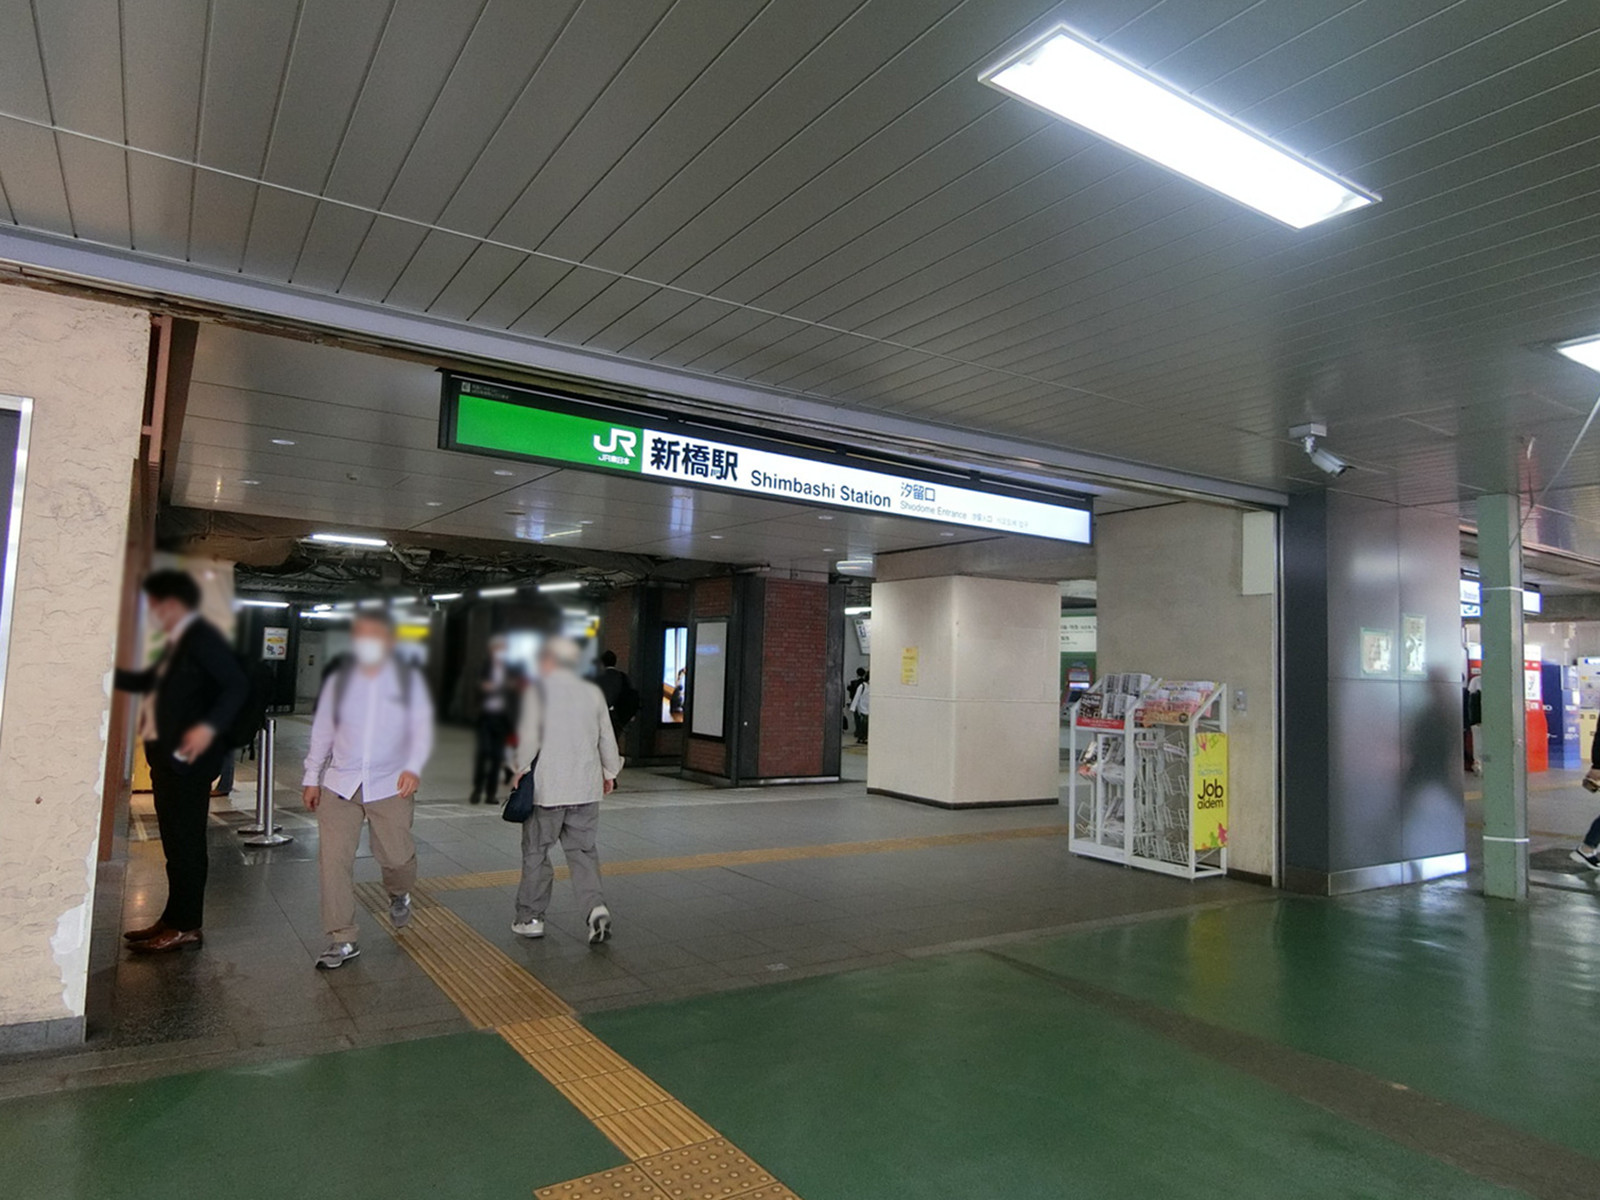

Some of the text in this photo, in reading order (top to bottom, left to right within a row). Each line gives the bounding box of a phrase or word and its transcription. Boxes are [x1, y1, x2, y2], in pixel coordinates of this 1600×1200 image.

[593, 428, 636, 457] JR
[650, 437, 738, 481] 新橋駅
[751, 470, 891, 508] Shimbashi Station
[900, 481, 936, 502] 汐留口
[900, 500, 967, 519] Shiodome Entrance
[1197, 778, 1224, 799] Job
[1197, 797, 1224, 809] aidem
